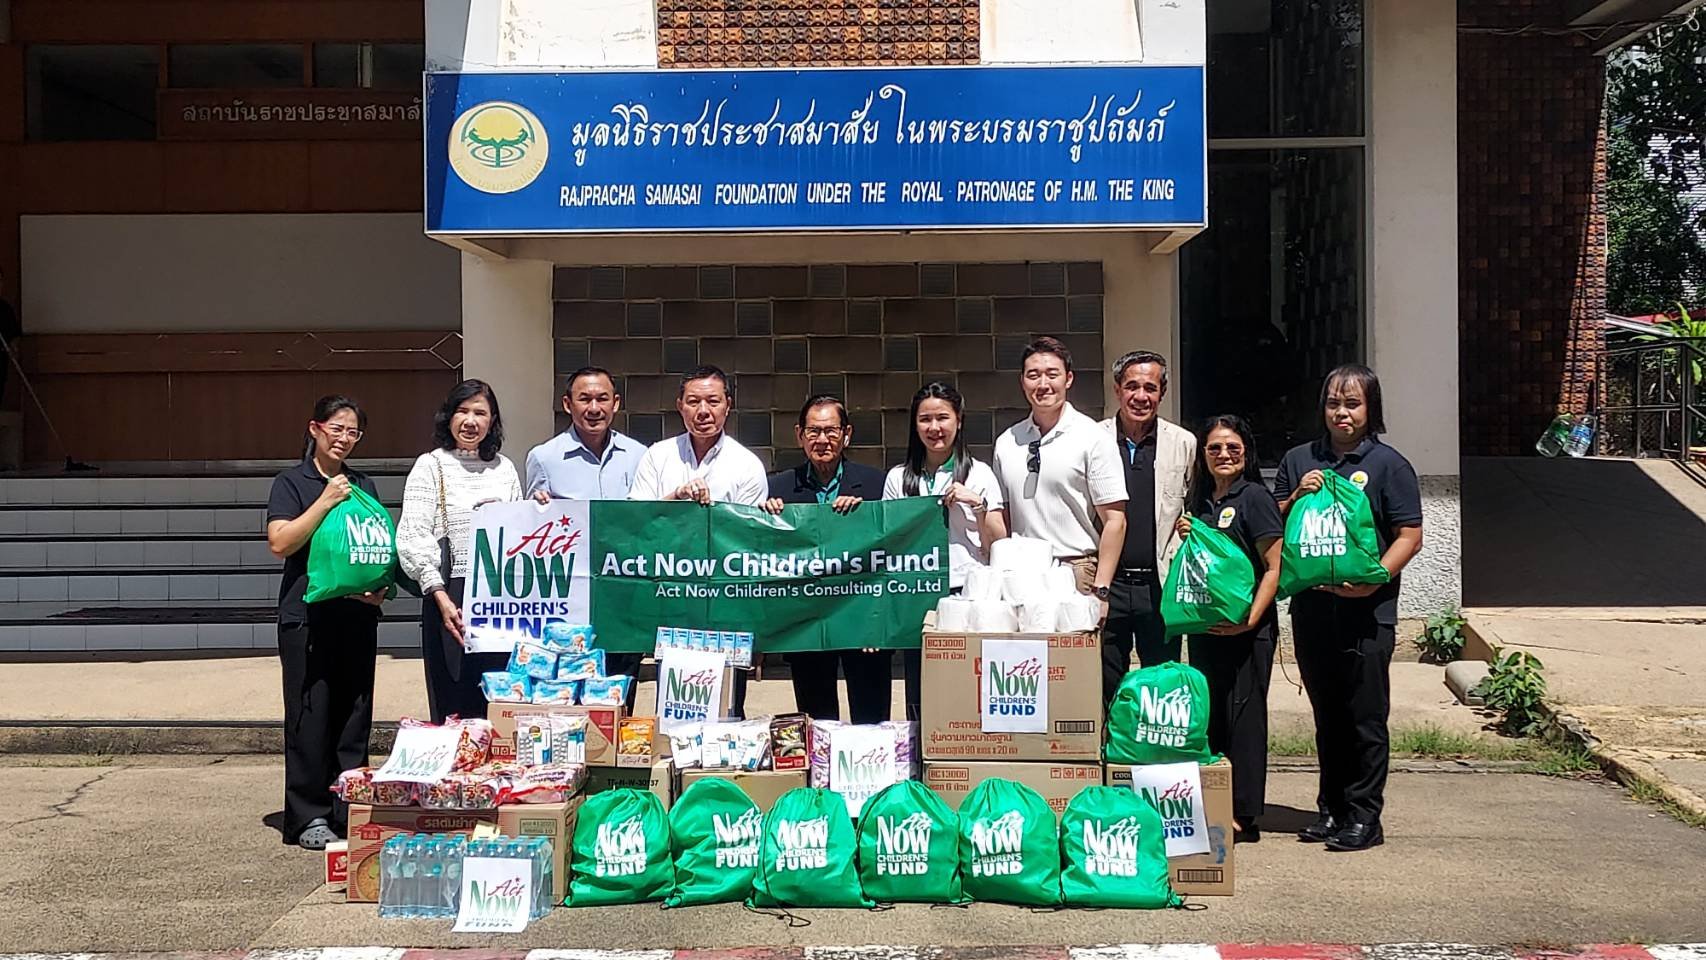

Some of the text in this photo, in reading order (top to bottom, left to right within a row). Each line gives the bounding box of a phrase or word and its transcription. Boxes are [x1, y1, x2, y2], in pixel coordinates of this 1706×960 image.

[183, 97, 422, 121] สถาบันราชประชาสมาสั
[571, 84, 1176, 167] มูลนิธิราชประชาสมาสัย ในพระบรมราชูปถัมภ์
[560, 178, 1175, 207] RAJPRACHA SAMASAI FOUNDATION UNDER THE ROYAL PATRONAGE OF H.M. THE KING
[506, 520, 582, 557] Act
[350, 552, 391, 565] FUND
[1300, 544, 1347, 558] FUND
[601, 546, 941, 577] Act Now Children's Fund
[656, 578, 942, 599] Act Now Children's Consulting Co.,Ltd
[1176, 591, 1212, 604] FUND
[471, 601, 569, 616] CHILDREN'S
[1006, 659, 1042, 676] Act
[683, 669, 717, 686] Act
[664, 707, 708, 720] FUND
[665, 701, 709, 713] CHILDREN'S
[989, 704, 1036, 716] FUND
[1138, 722, 1189, 736] CHILDREN'S
[1135, 729, 1187, 748] FUND
[1159, 781, 1194, 800] Act
[1163, 818, 1194, 828] DREN'S
[1162, 826, 1194, 839] UND
[776, 856, 828, 872] FUND
[877, 853, 928, 863] CHILDREN'S
[972, 853, 1022, 865] CHILDREN'S
[595, 862, 647, 878] FUND
[877, 861, 929, 876] FUND
[972, 861, 1024, 878] FUND
[1085, 861, 1138, 877] FUND
[488, 879, 525, 896] Act
